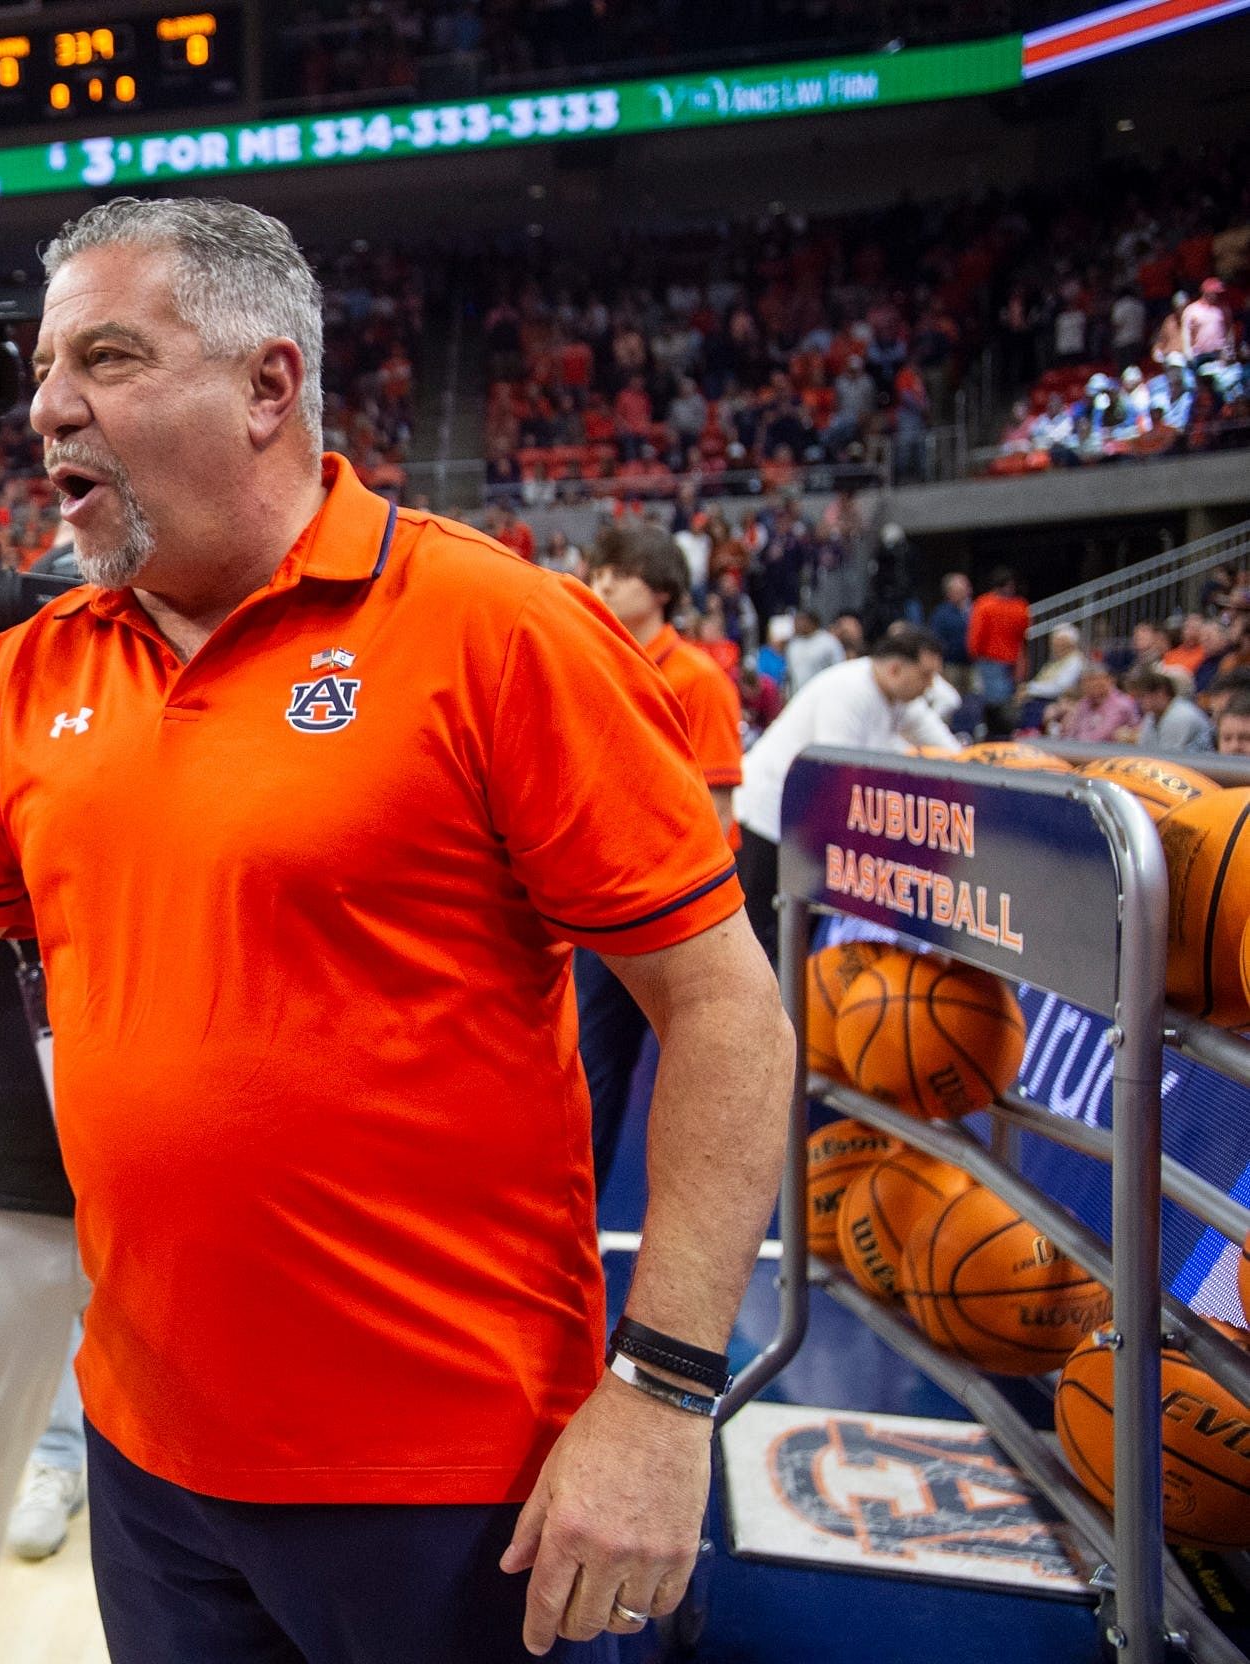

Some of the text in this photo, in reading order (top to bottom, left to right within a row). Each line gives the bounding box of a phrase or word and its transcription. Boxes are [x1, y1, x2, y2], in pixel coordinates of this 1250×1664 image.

[141, 131, 230, 176] FOR
[237, 122, 301, 166] ME
[311, 89, 619, 159] 334-333-3333
[847, 783, 976, 859] AUBURN
[825, 842, 1024, 955] BASKETBALL
